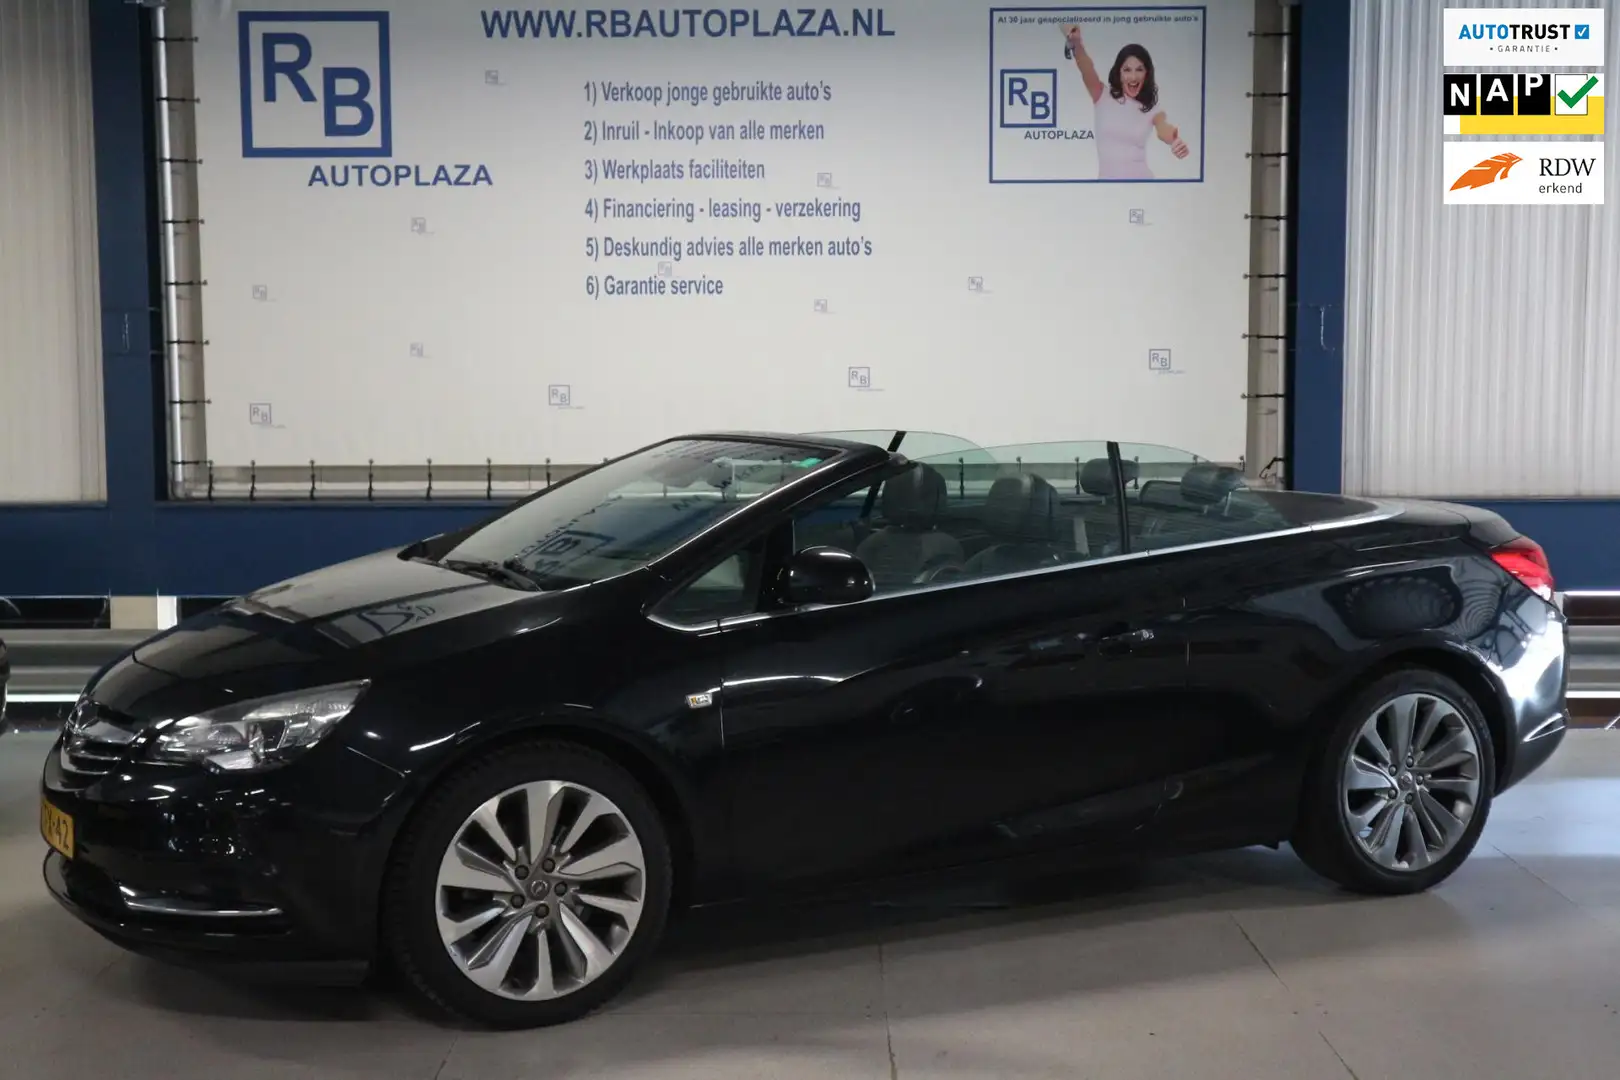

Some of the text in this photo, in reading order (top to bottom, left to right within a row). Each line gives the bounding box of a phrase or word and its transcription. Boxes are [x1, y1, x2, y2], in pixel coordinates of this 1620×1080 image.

[481, 8, 896, 39] WWW.RBAUTOPLAZA.NL
[262, 33, 375, 137] RB
[584, 80, 832, 107] 1) Verkoop jonge gebruikte auto's
[1008, 77, 1051, 120] RB
[584, 120, 598, 146] 2)
[602, 120, 640, 141] Inruil
[653, 120, 705, 146] Inkoop
[709, 124, 735, 141] van
[739, 120, 765, 140] alle
[769, 119, 825, 140] merken
[1023, 130, 1095, 141] AUTOPLAZA
[308, 164, 494, 188] AUTOPLAZA
[584, 158, 765, 184] 3) Werkplaats faciliteiten
[584, 198, 598, 223] 4)
[603, 197, 695, 223] Financiering
[708, 197, 762, 223] leasing
[775, 196, 861, 223] verzekering
[585, 235, 873, 262] 5) Deskundig advies alle merken auto's
[586, 274, 724, 301] 6) Garantie service
